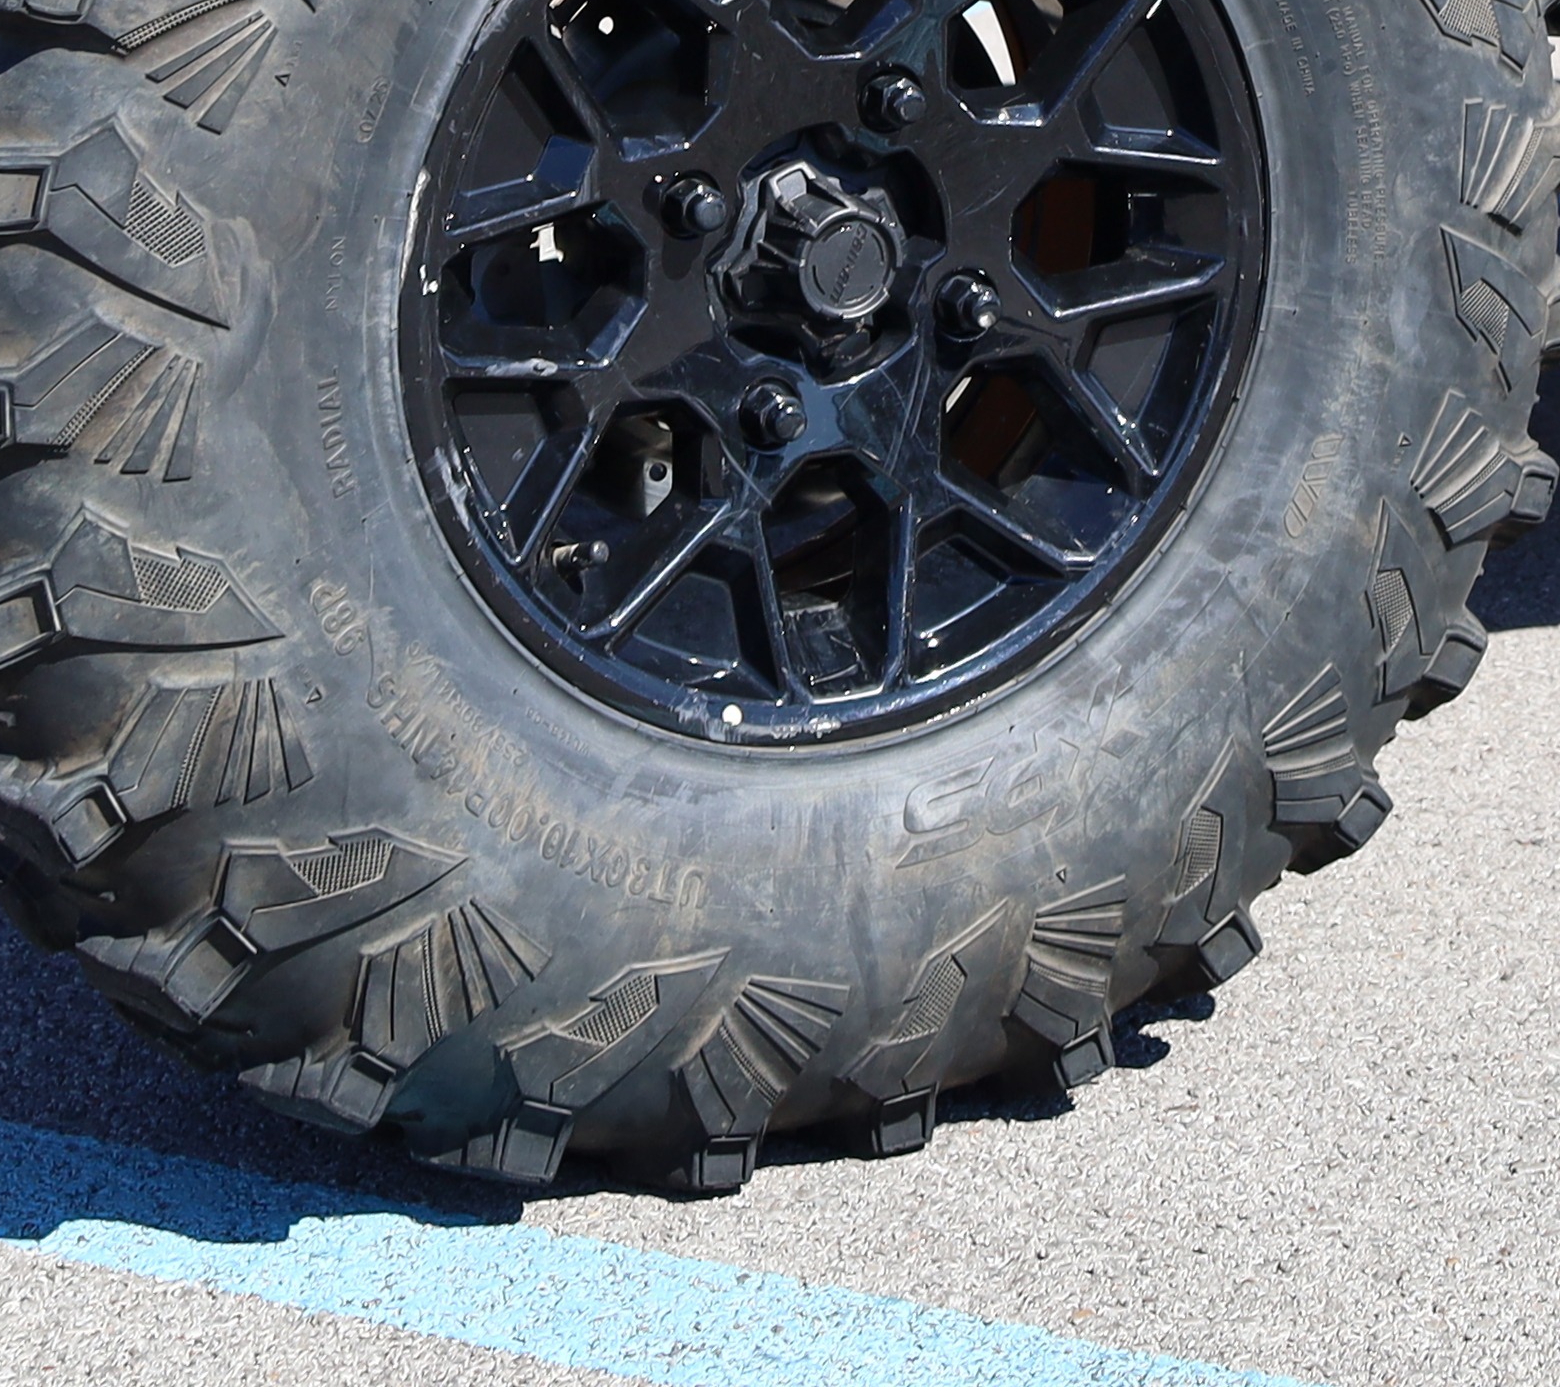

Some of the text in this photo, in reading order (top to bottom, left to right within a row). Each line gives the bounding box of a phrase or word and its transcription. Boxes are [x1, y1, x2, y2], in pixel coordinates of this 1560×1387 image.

[1296, 56, 1316, 97] CHINA
[325, 235, 347, 313] NYLON
[316, 364, 354, 500] RADIAL
[309, 575, 365, 657] 98P
[366, 673, 441, 764] NHS
